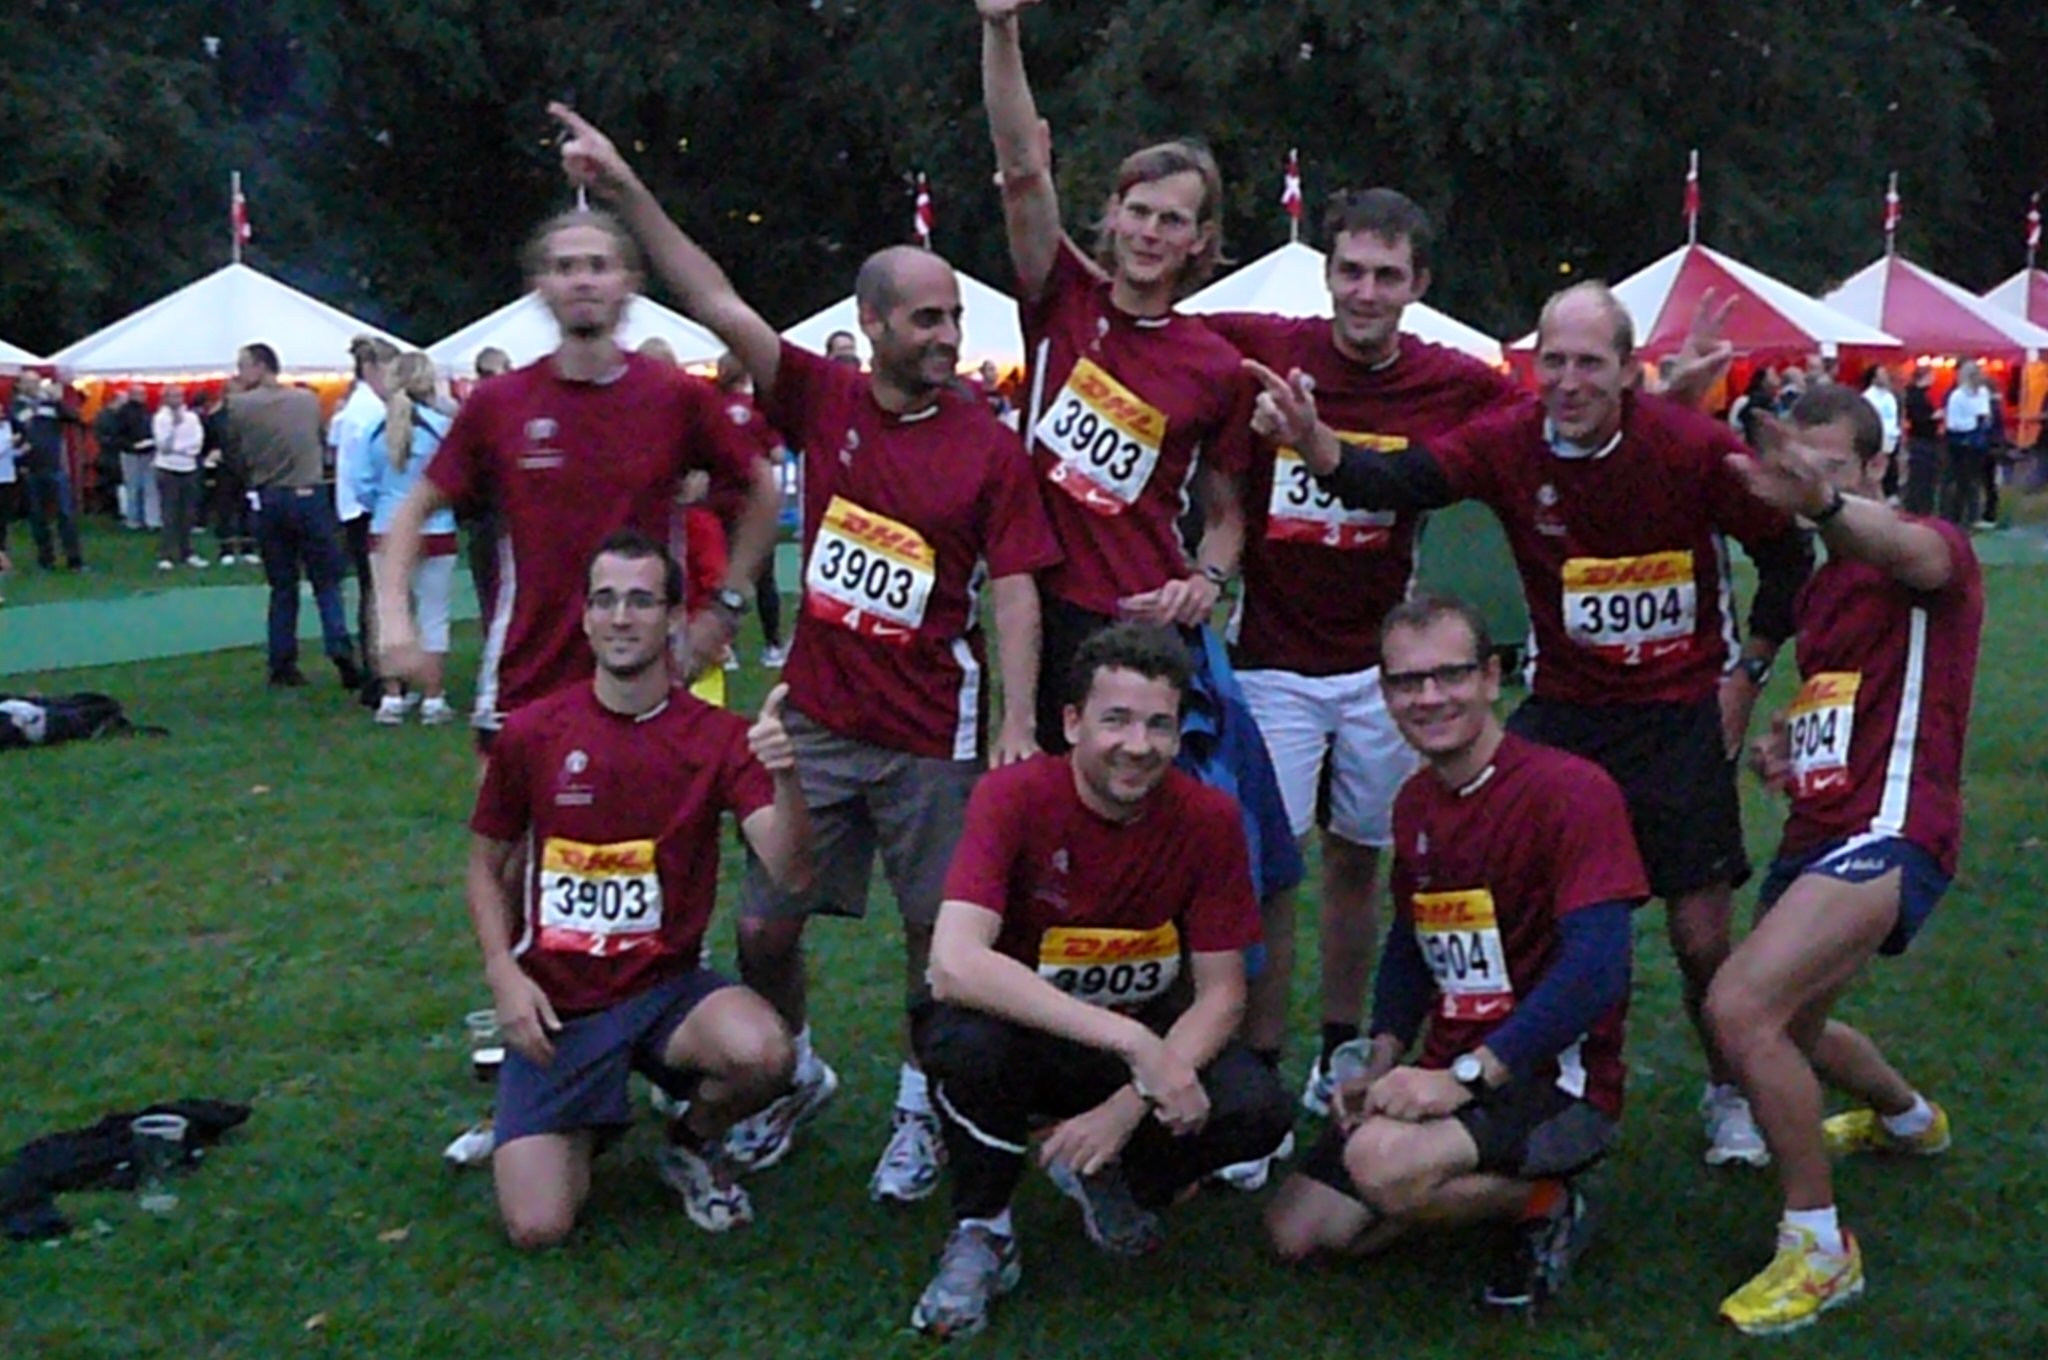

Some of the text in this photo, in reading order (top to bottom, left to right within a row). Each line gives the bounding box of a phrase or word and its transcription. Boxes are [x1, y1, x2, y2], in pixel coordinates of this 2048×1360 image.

[1077, 374, 1157, 440] DHL
[1053, 399, 1143, 481] 3903
[839, 510, 926, 562] DHL
[820, 539, 914, 610] 3903
[1583, 560, 1681, 587] DHL
[1579, 587, 1682, 634] 3904
[1623, 644, 1642, 665] 2
[1788, 707, 1838, 759] 904
[559, 848, 648, 873] DHL
[553, 876, 648, 920] 3903
[588, 932, 608, 957] 2
[1062, 935, 1160, 959] DHL
